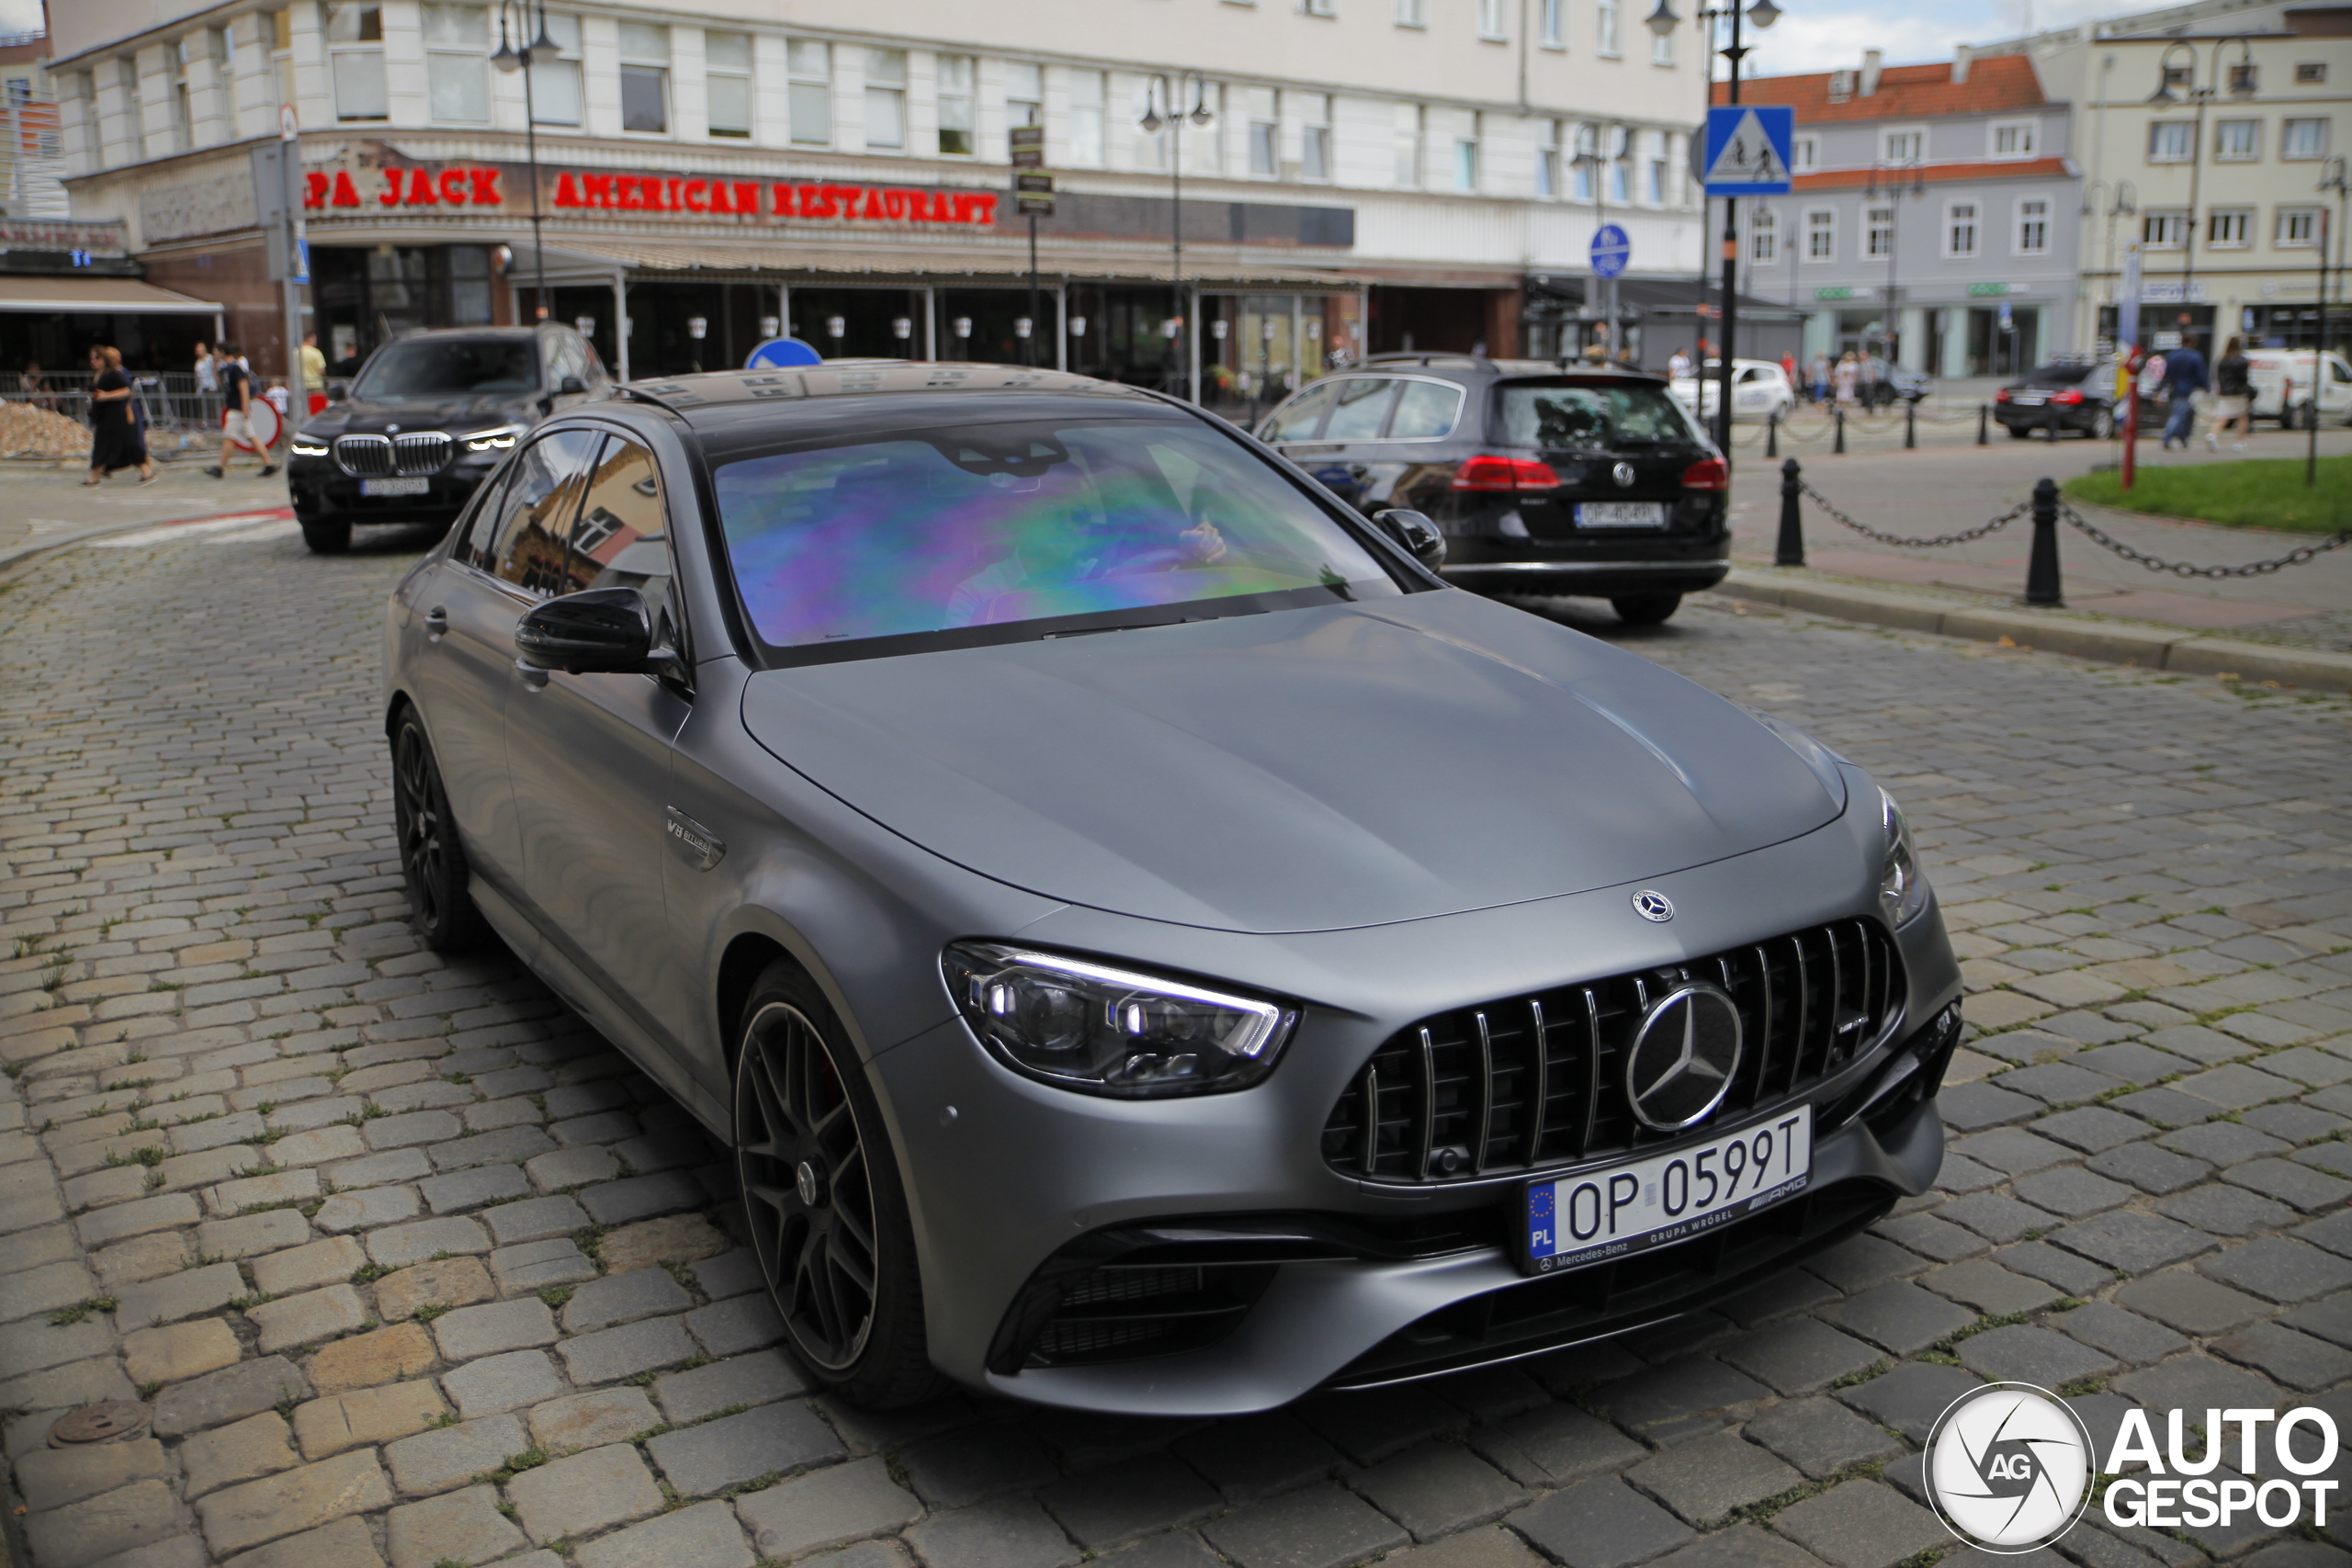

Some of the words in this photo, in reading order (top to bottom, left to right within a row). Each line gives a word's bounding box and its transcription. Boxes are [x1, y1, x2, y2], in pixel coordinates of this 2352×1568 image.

[379, 167, 503, 206] JACK
[553, 172, 761, 215] AMERICAN
[772, 183, 998, 225] RESTAURANT
[1569, 1171, 1639, 1240] OP
[1662, 1115, 1800, 1216] 0599T
[1532, 1230, 1552, 1247] PL
[1650, 1226, 1688, 1244] GRUPA
[1691, 1210, 1733, 1231] WRÓBEL
[1556, 1242, 1628, 1267] Mercedes-Benz
